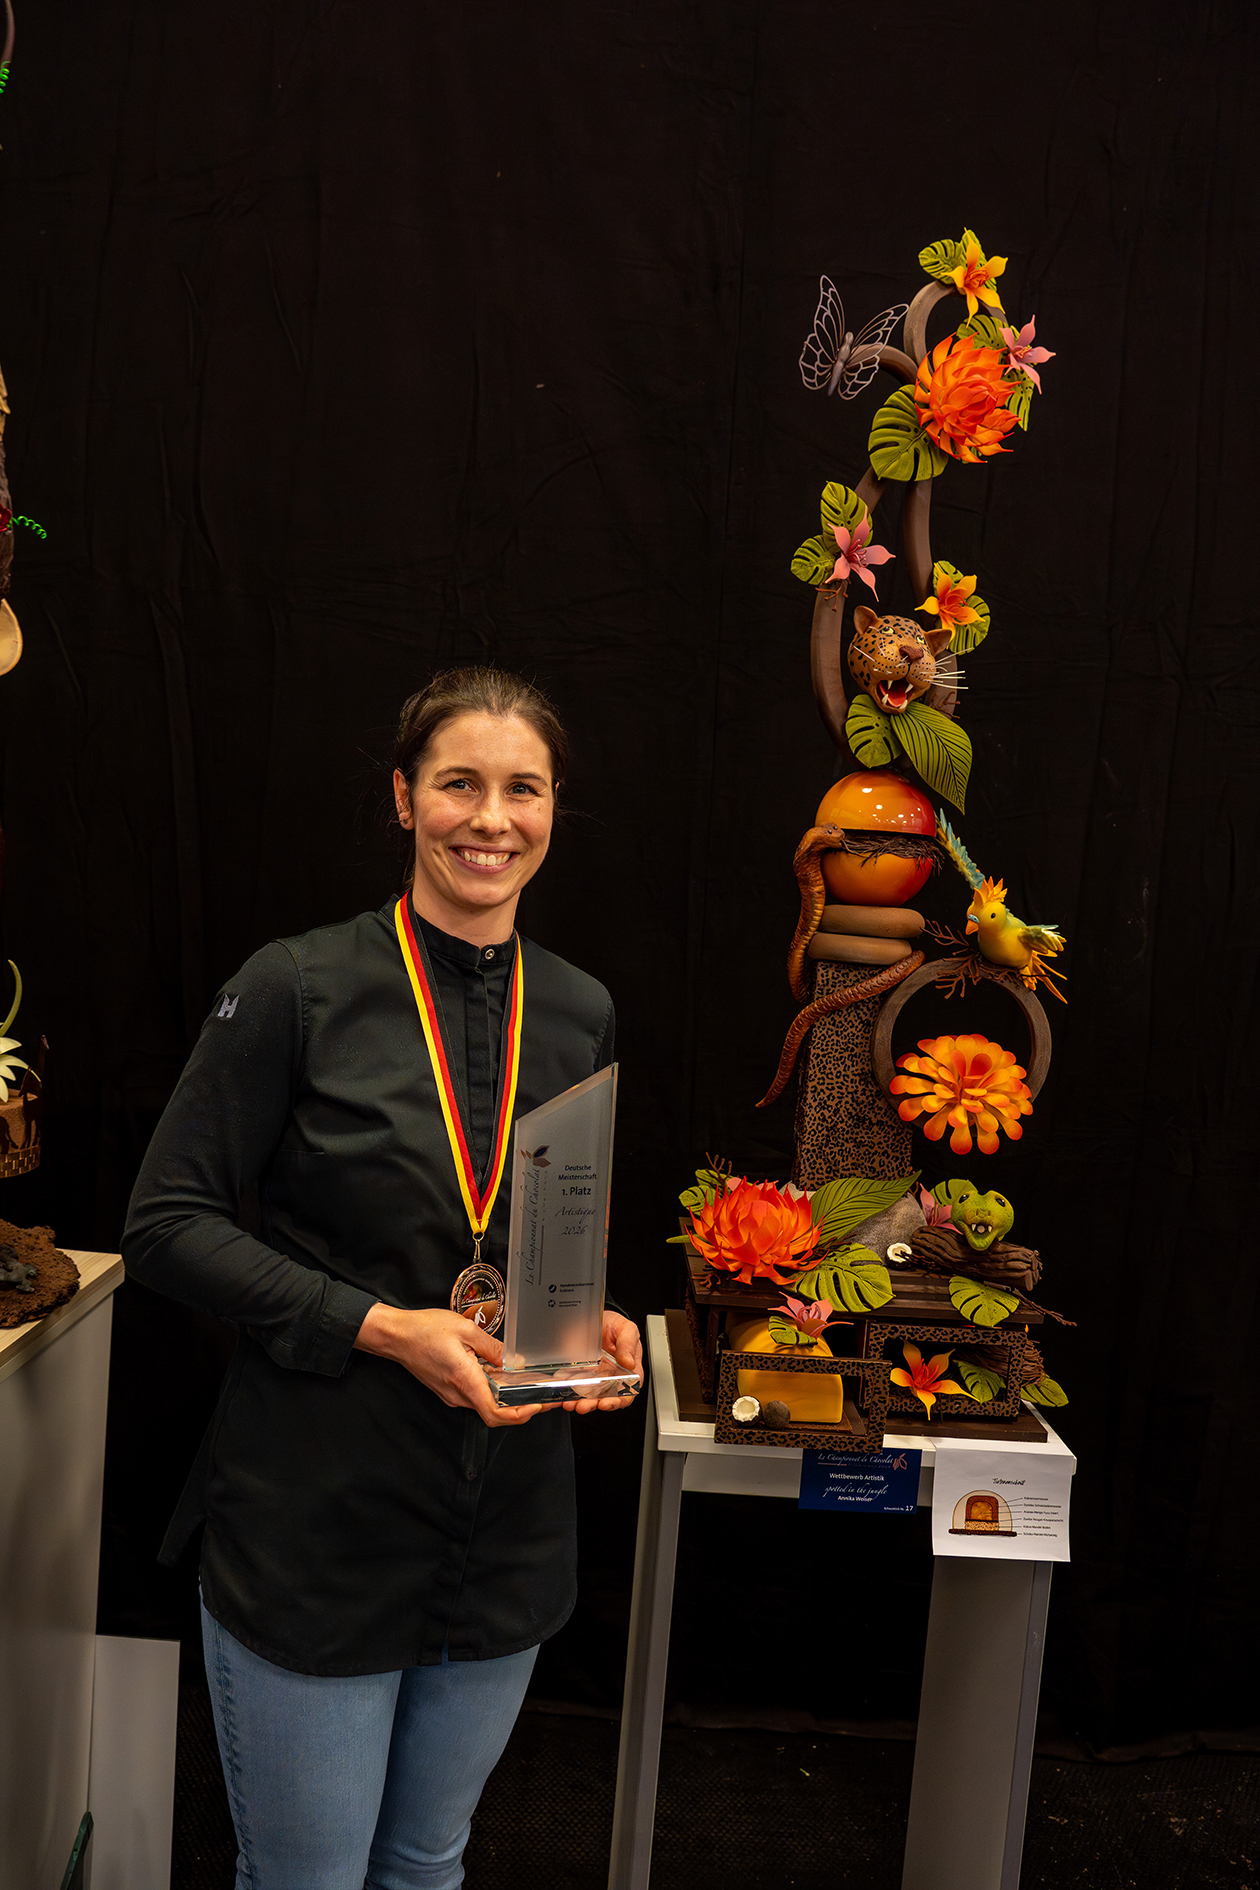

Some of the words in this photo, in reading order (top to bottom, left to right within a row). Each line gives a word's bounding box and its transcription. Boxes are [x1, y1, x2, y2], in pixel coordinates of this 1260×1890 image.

[525, 1168, 540, 1205] Chocolat
[562, 1188, 568, 1196] 1.
[570, 1186, 592, 1196] Platz
[555, 1206, 597, 1224] Artistique
[561, 1225, 589, 1236] 2026
[829, 1473, 863, 1481] Wettbewerb
[864, 1474, 885, 1482] Artistik
